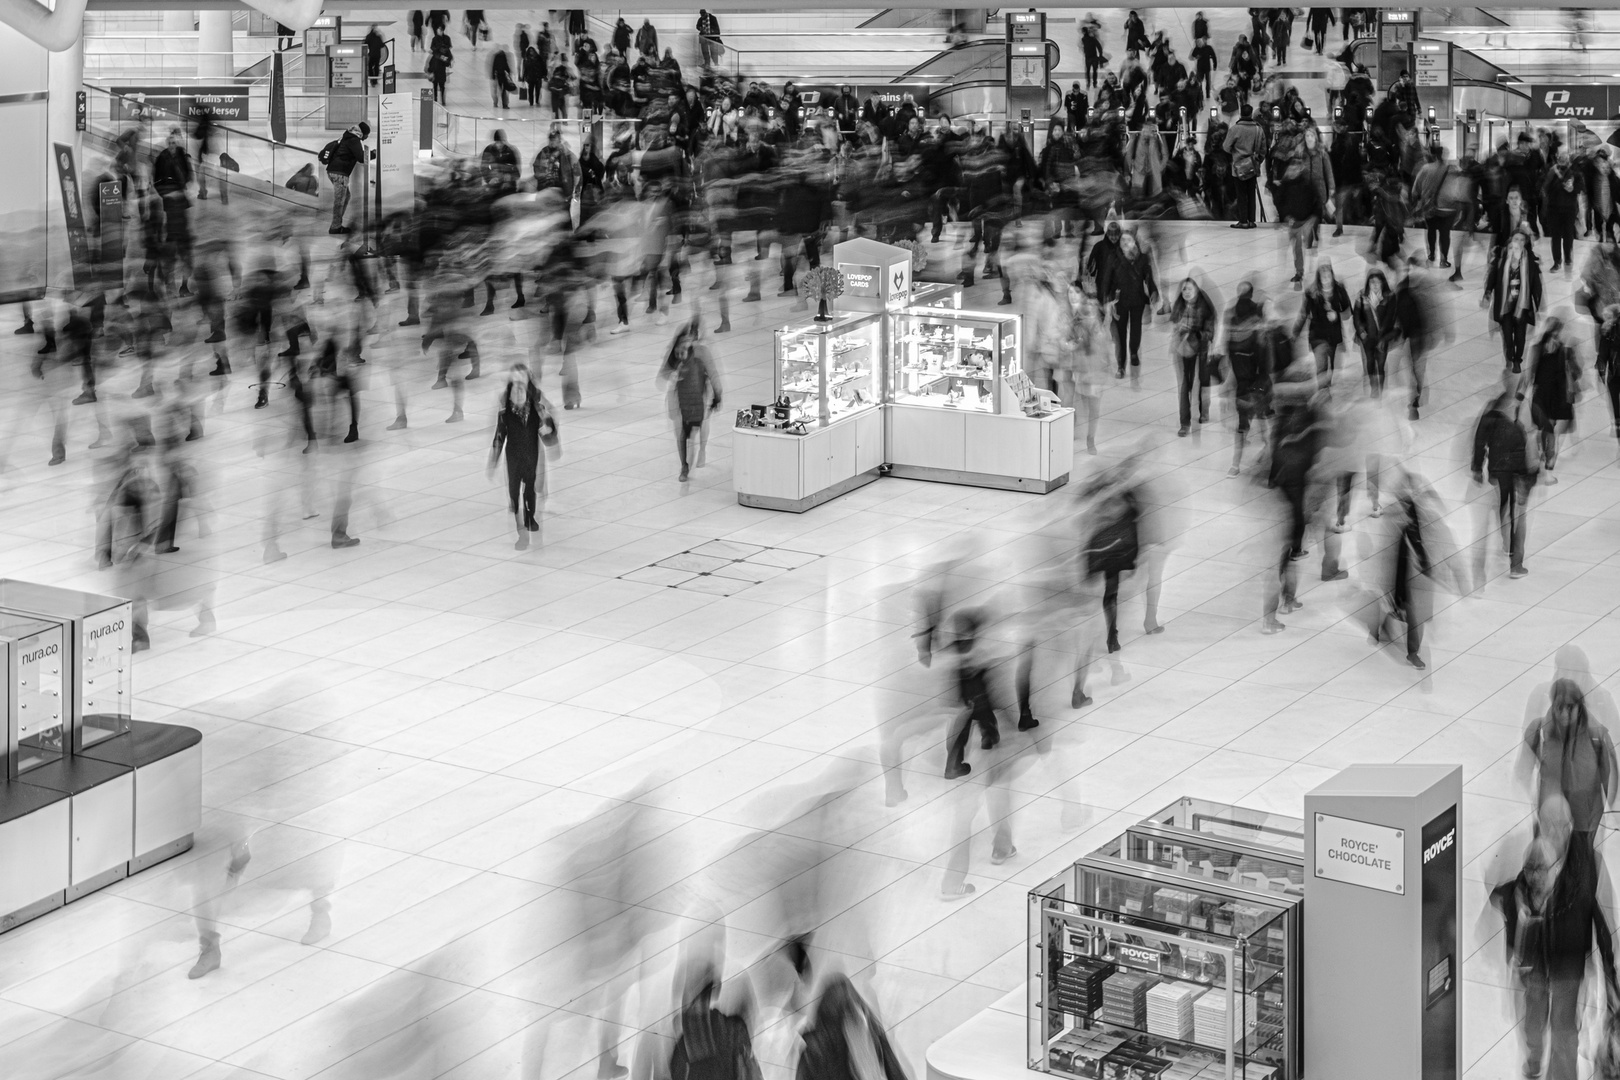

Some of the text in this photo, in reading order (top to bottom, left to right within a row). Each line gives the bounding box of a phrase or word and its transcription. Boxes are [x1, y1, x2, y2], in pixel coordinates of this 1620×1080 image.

[195, 93, 234, 103] Trains to
[189, 106, 240, 117] New Jersey
[1554, 106, 1595, 116] PATH
[847, 273, 873, 281] LOVEPOP
[889, 290, 908, 301] lovepop
[90, 620, 124, 640] nura.co
[22, 643, 58, 665] nura.co
[1341, 837, 1378, 853] ROYCE'
[1328, 849, 1391, 870] CHOCOLATE
